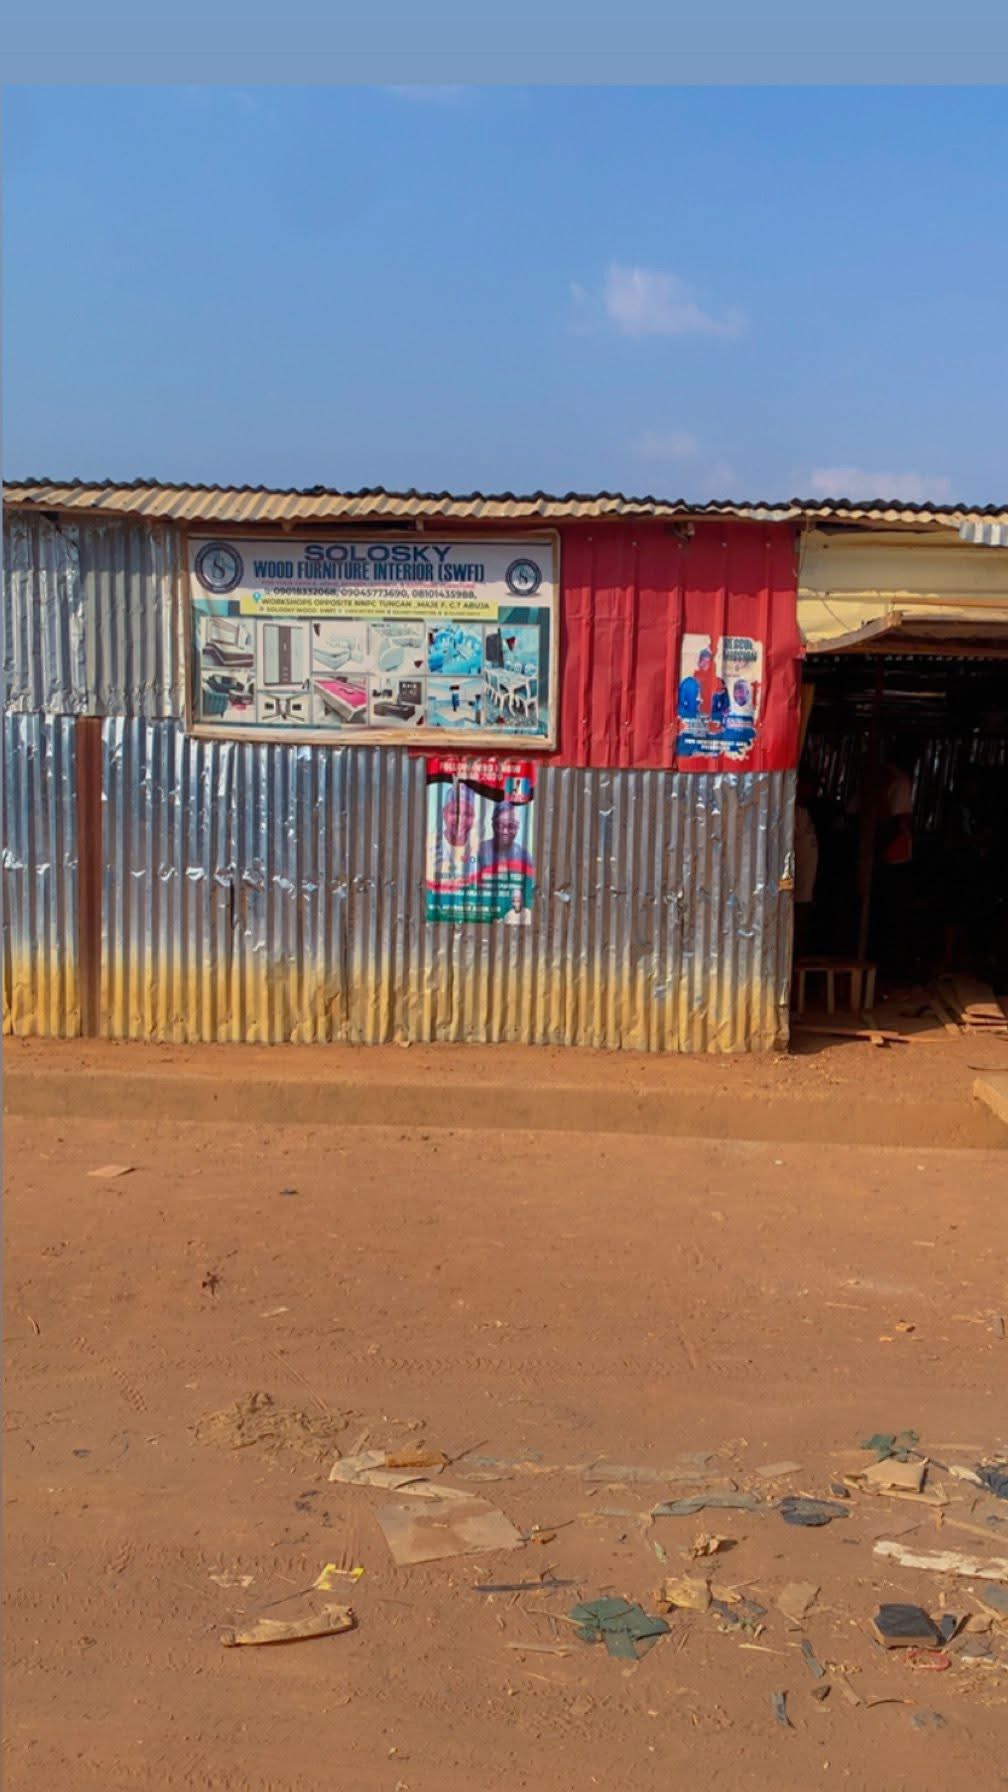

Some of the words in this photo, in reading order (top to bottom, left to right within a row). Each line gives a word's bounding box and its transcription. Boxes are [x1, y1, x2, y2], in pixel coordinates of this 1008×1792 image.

[304, 545, 451, 561] SOLOSKY
[254, 561, 293, 578] WOOD
[297, 561, 369, 580] FURNITURE
[373, 563, 433, 582] INTERIOR
[314, 599, 353, 607] OPPOSITE
